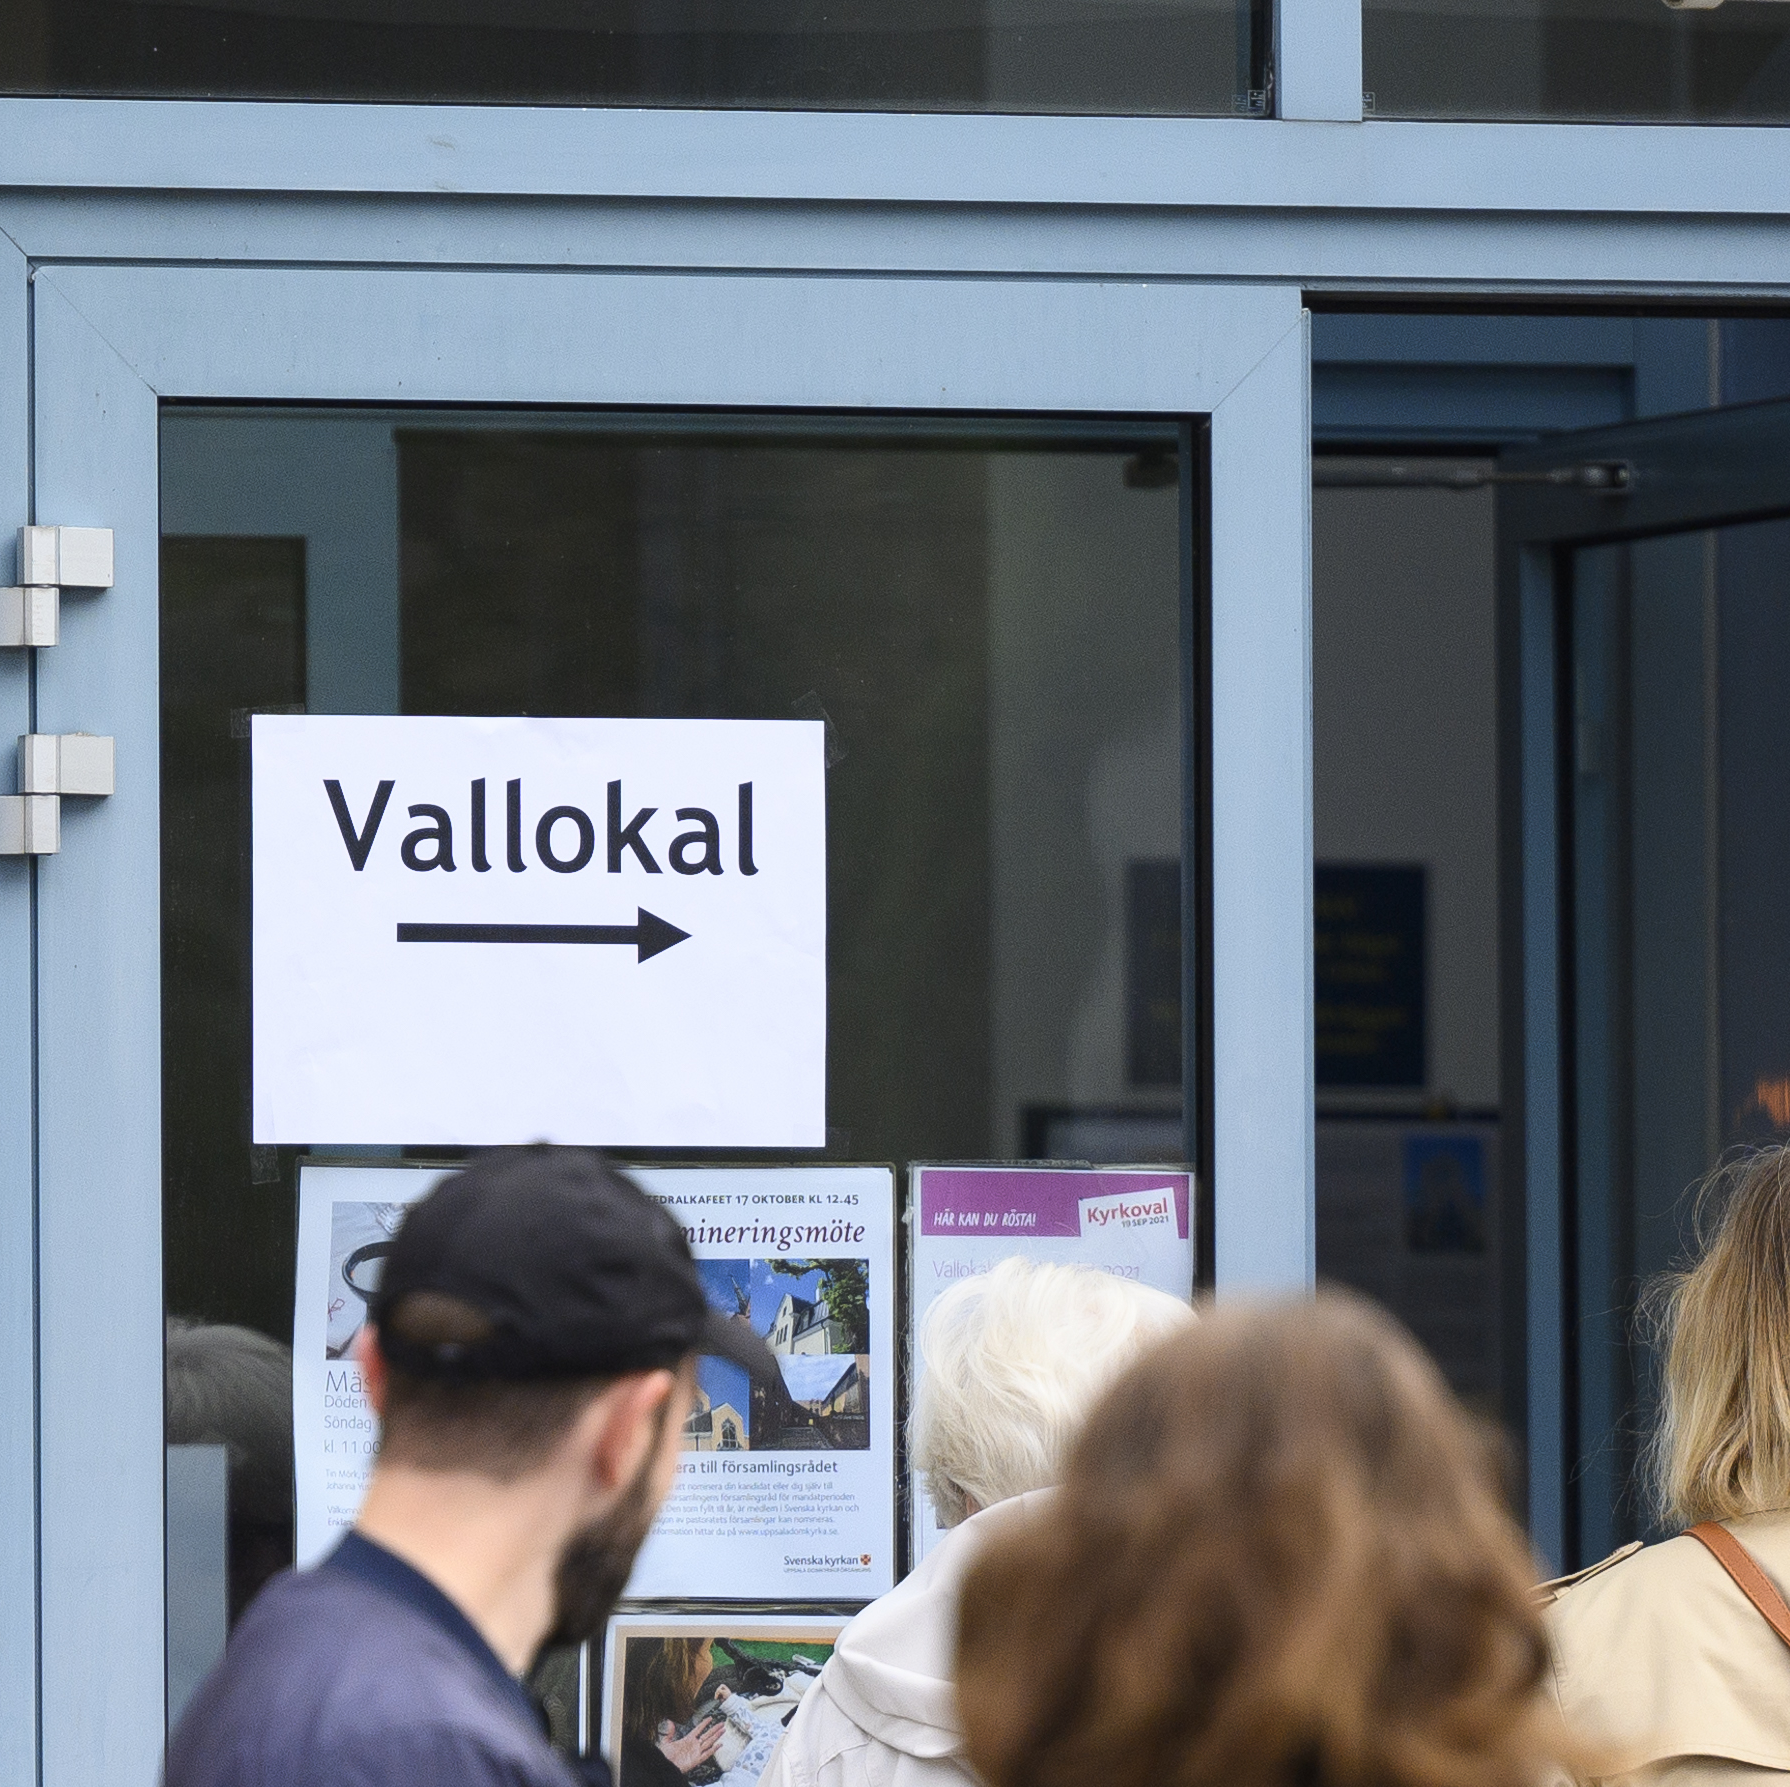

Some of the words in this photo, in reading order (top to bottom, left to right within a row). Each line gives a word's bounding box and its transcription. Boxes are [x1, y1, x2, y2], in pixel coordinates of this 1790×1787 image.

[322, 777, 759, 876] Vallokal
[647, 1194, 731, 1205] TEDRALKAFEET
[736, 1195, 748, 1206] 17
[751, 1194, 805, 1205] OKTOBER
[809, 1194, 822, 1205] KL
[826, 1194, 859, 1205] 12.45
[933, 1208, 955, 1227] HÄR
[959, 1213, 980, 1227] KAN
[983, 1214, 998, 1227] DU
[1001, 1208, 1036, 1227] RÖSTA!
[1087, 1197, 1169, 1226] Kyrkoval
[1121, 1220, 1131, 1228] 19
[1132, 1218, 1148, 1228] SEP
[1149, 1215, 1169, 1226] 2021
[680, 1218, 865, 1252] mineringsmöte
[324, 1394, 367, 1408] Döden
[324, 1414, 372, 1433] Söndag
[324, 1439, 337, 1454] kl.
[342, 1440, 382, 1455] 11.00
[675, 1463, 696, 1473] era
[700, 1459, 718, 1473] till
[722, 1459, 838, 1477] församlingsrådet
[817, 1503, 843, 1515] kyrkan
[783, 1554, 823, 1566] Svenska
[824, 1554, 859, 1568] kyrkan
